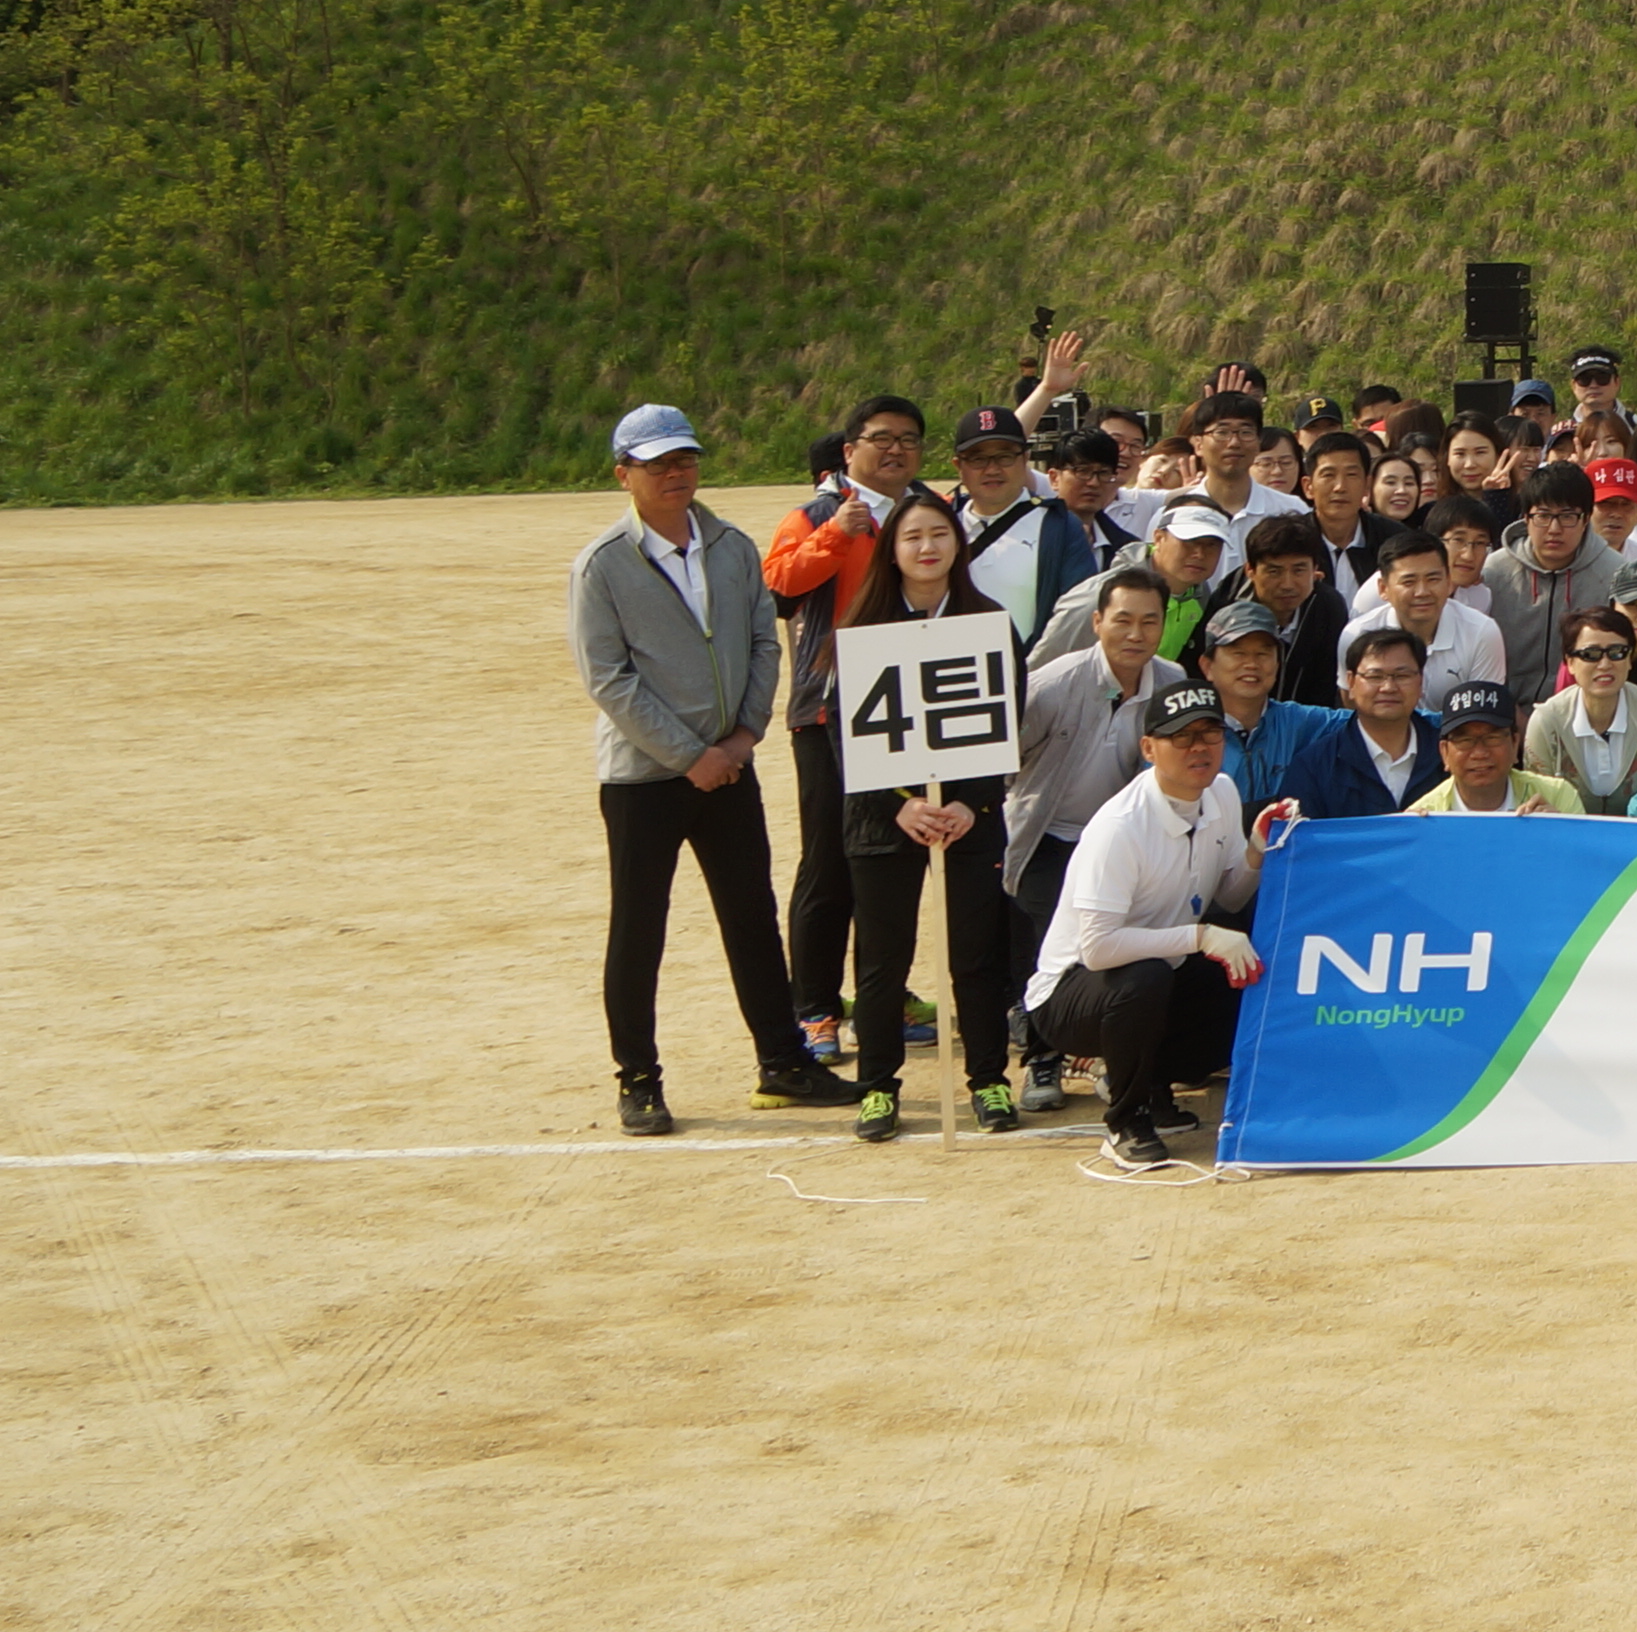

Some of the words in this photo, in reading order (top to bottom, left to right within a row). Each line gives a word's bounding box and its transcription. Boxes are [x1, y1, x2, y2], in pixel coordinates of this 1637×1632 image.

[1309, 397, 1327, 417] P
[979, 410, 997, 431] B
[1594, 467, 1607, 484] 나
[1612, 467, 1636, 485] 심판
[851, 650, 1009, 754] 4팀
[1163, 688, 1217, 716] STAFF
[1449, 689, 1499, 711] 상임이사
[1296, 931, 1493, 995] NH
[1314, 1004, 1466, 1030] NongHyup
